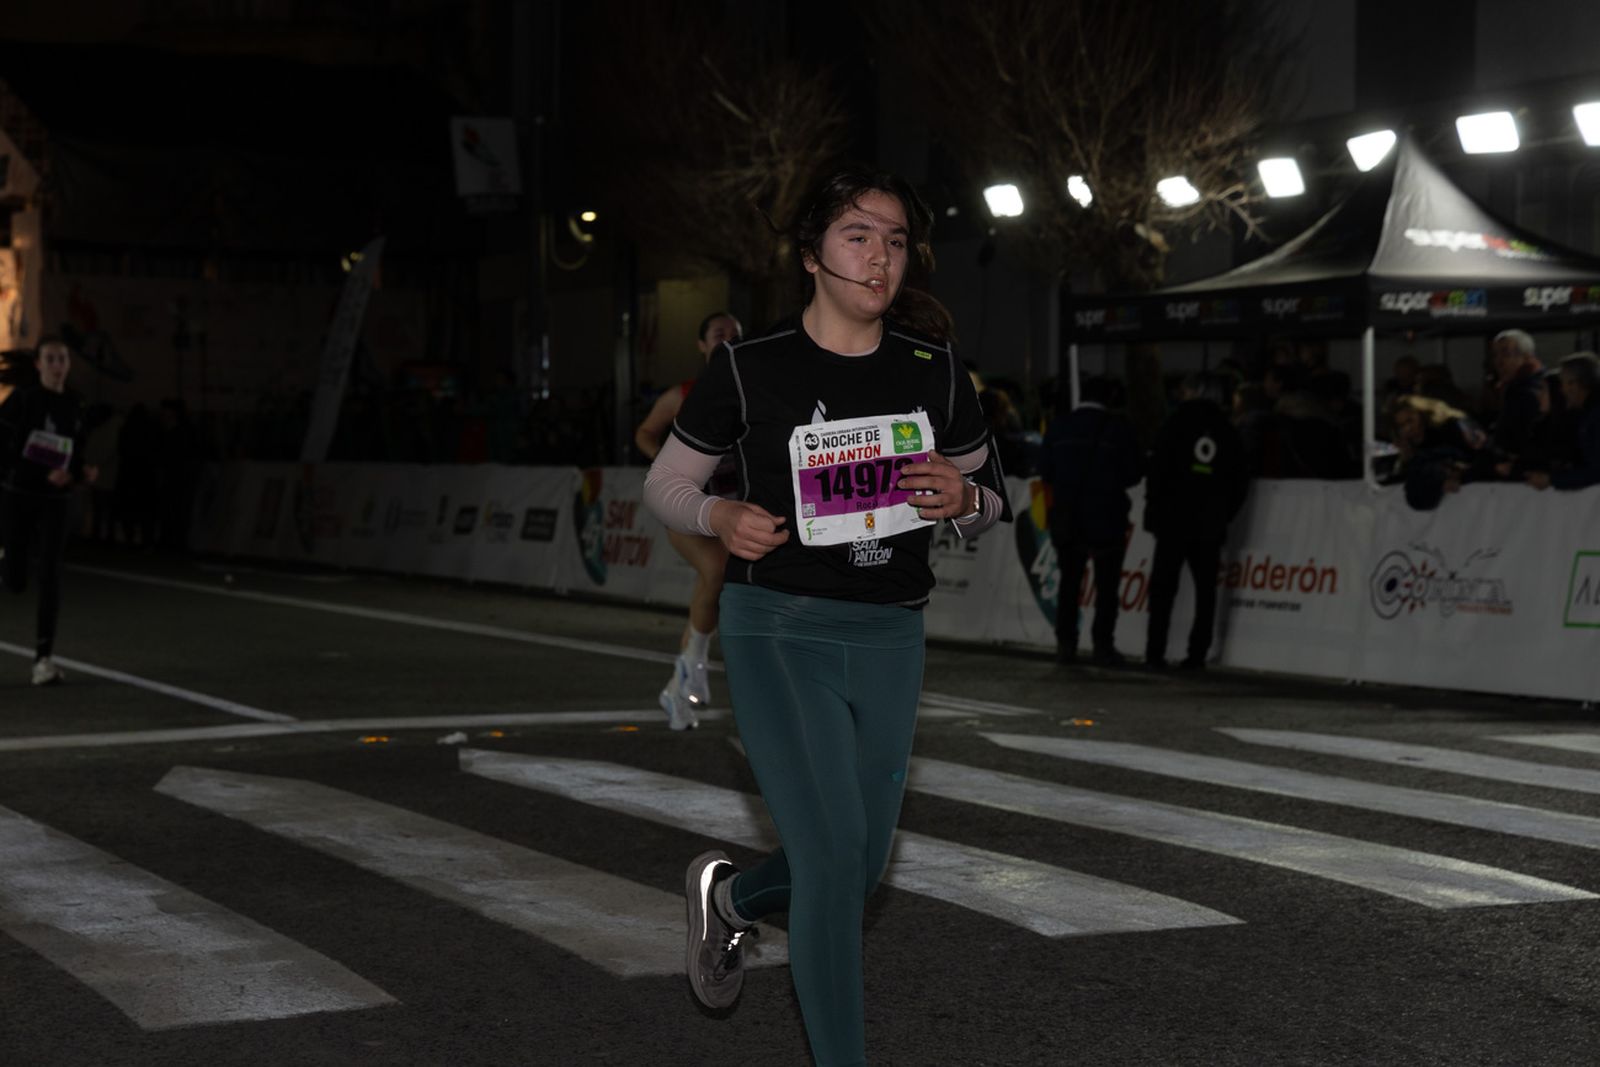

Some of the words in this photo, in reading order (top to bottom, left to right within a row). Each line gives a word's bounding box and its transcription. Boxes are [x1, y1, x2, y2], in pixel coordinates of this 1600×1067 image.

[822, 432, 863, 449] NOCHE
[865, 429, 880, 442] DE
[808, 452, 834, 468] SAN
[838, 442, 881, 463] ANTÓN
[852, 538, 880, 552] SAN
[854, 546, 893, 563] ANTÓN
